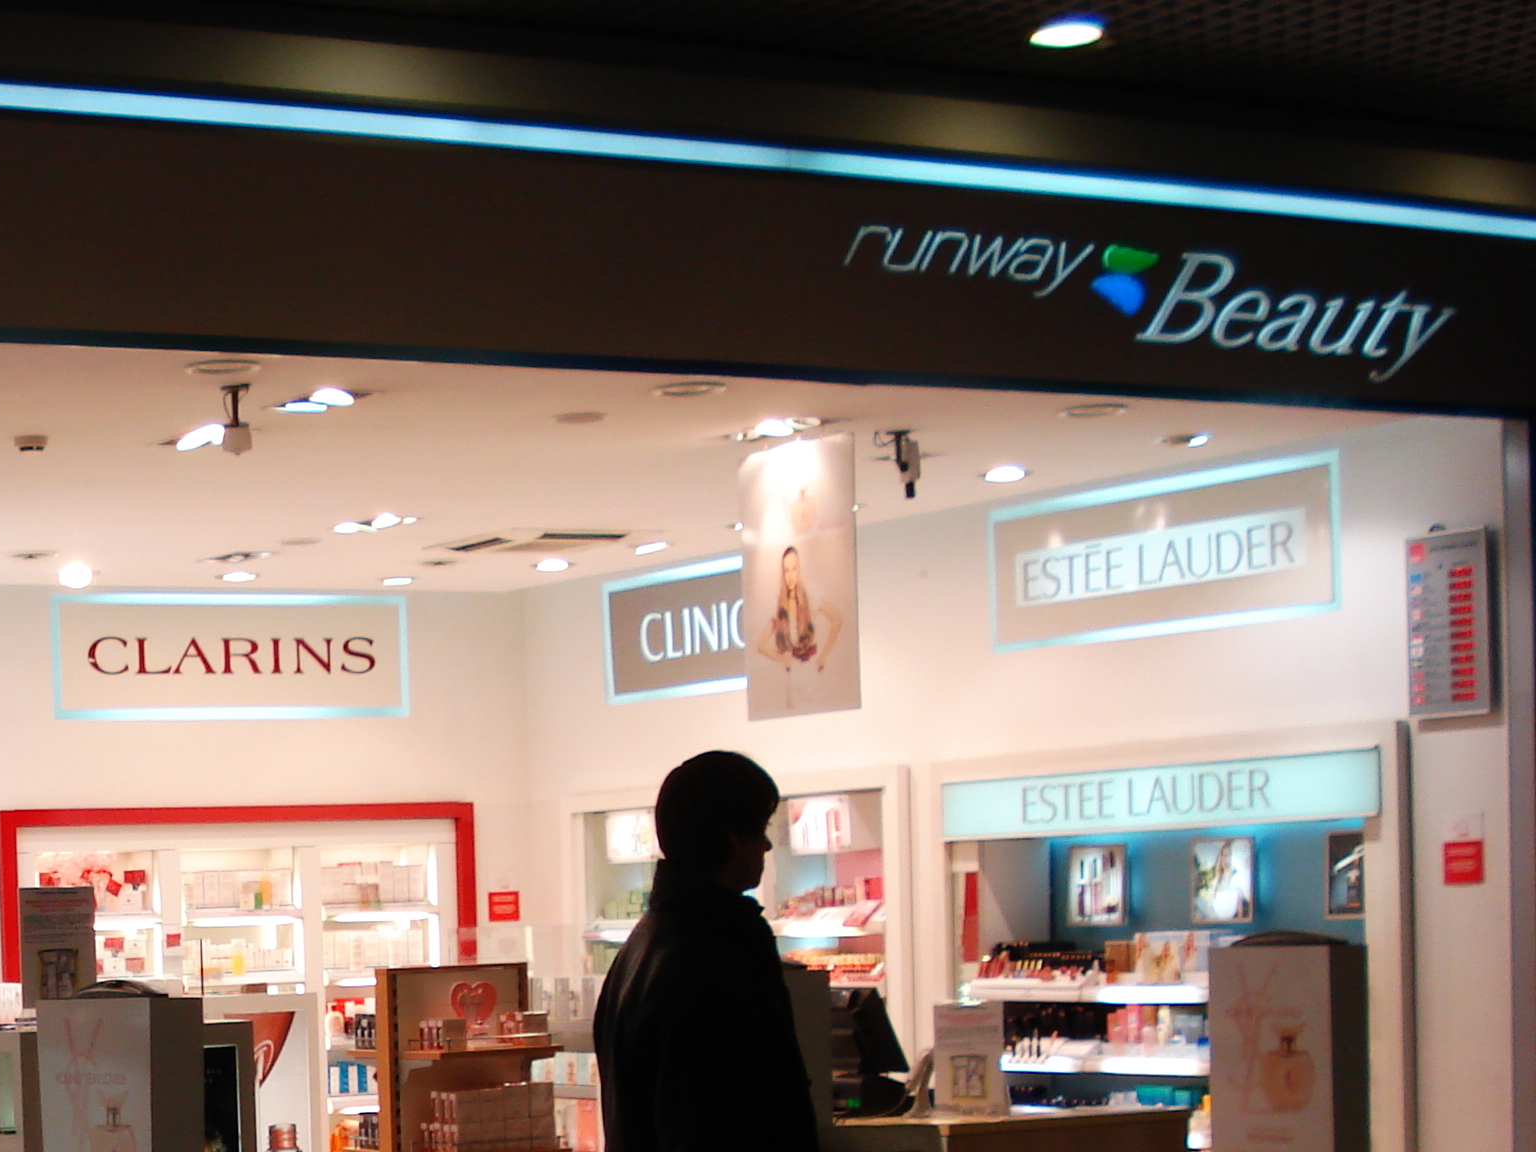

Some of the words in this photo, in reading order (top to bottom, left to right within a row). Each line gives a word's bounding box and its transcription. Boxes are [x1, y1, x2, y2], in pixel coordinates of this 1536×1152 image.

[844, 222, 1097, 298] runway
[1136, 251, 1457, 383] Beauty
[1138, 521, 1296, 586] LAUDER
[87, 636, 377, 676] CLARINS
[1127, 768, 1271, 818] LAUDER
